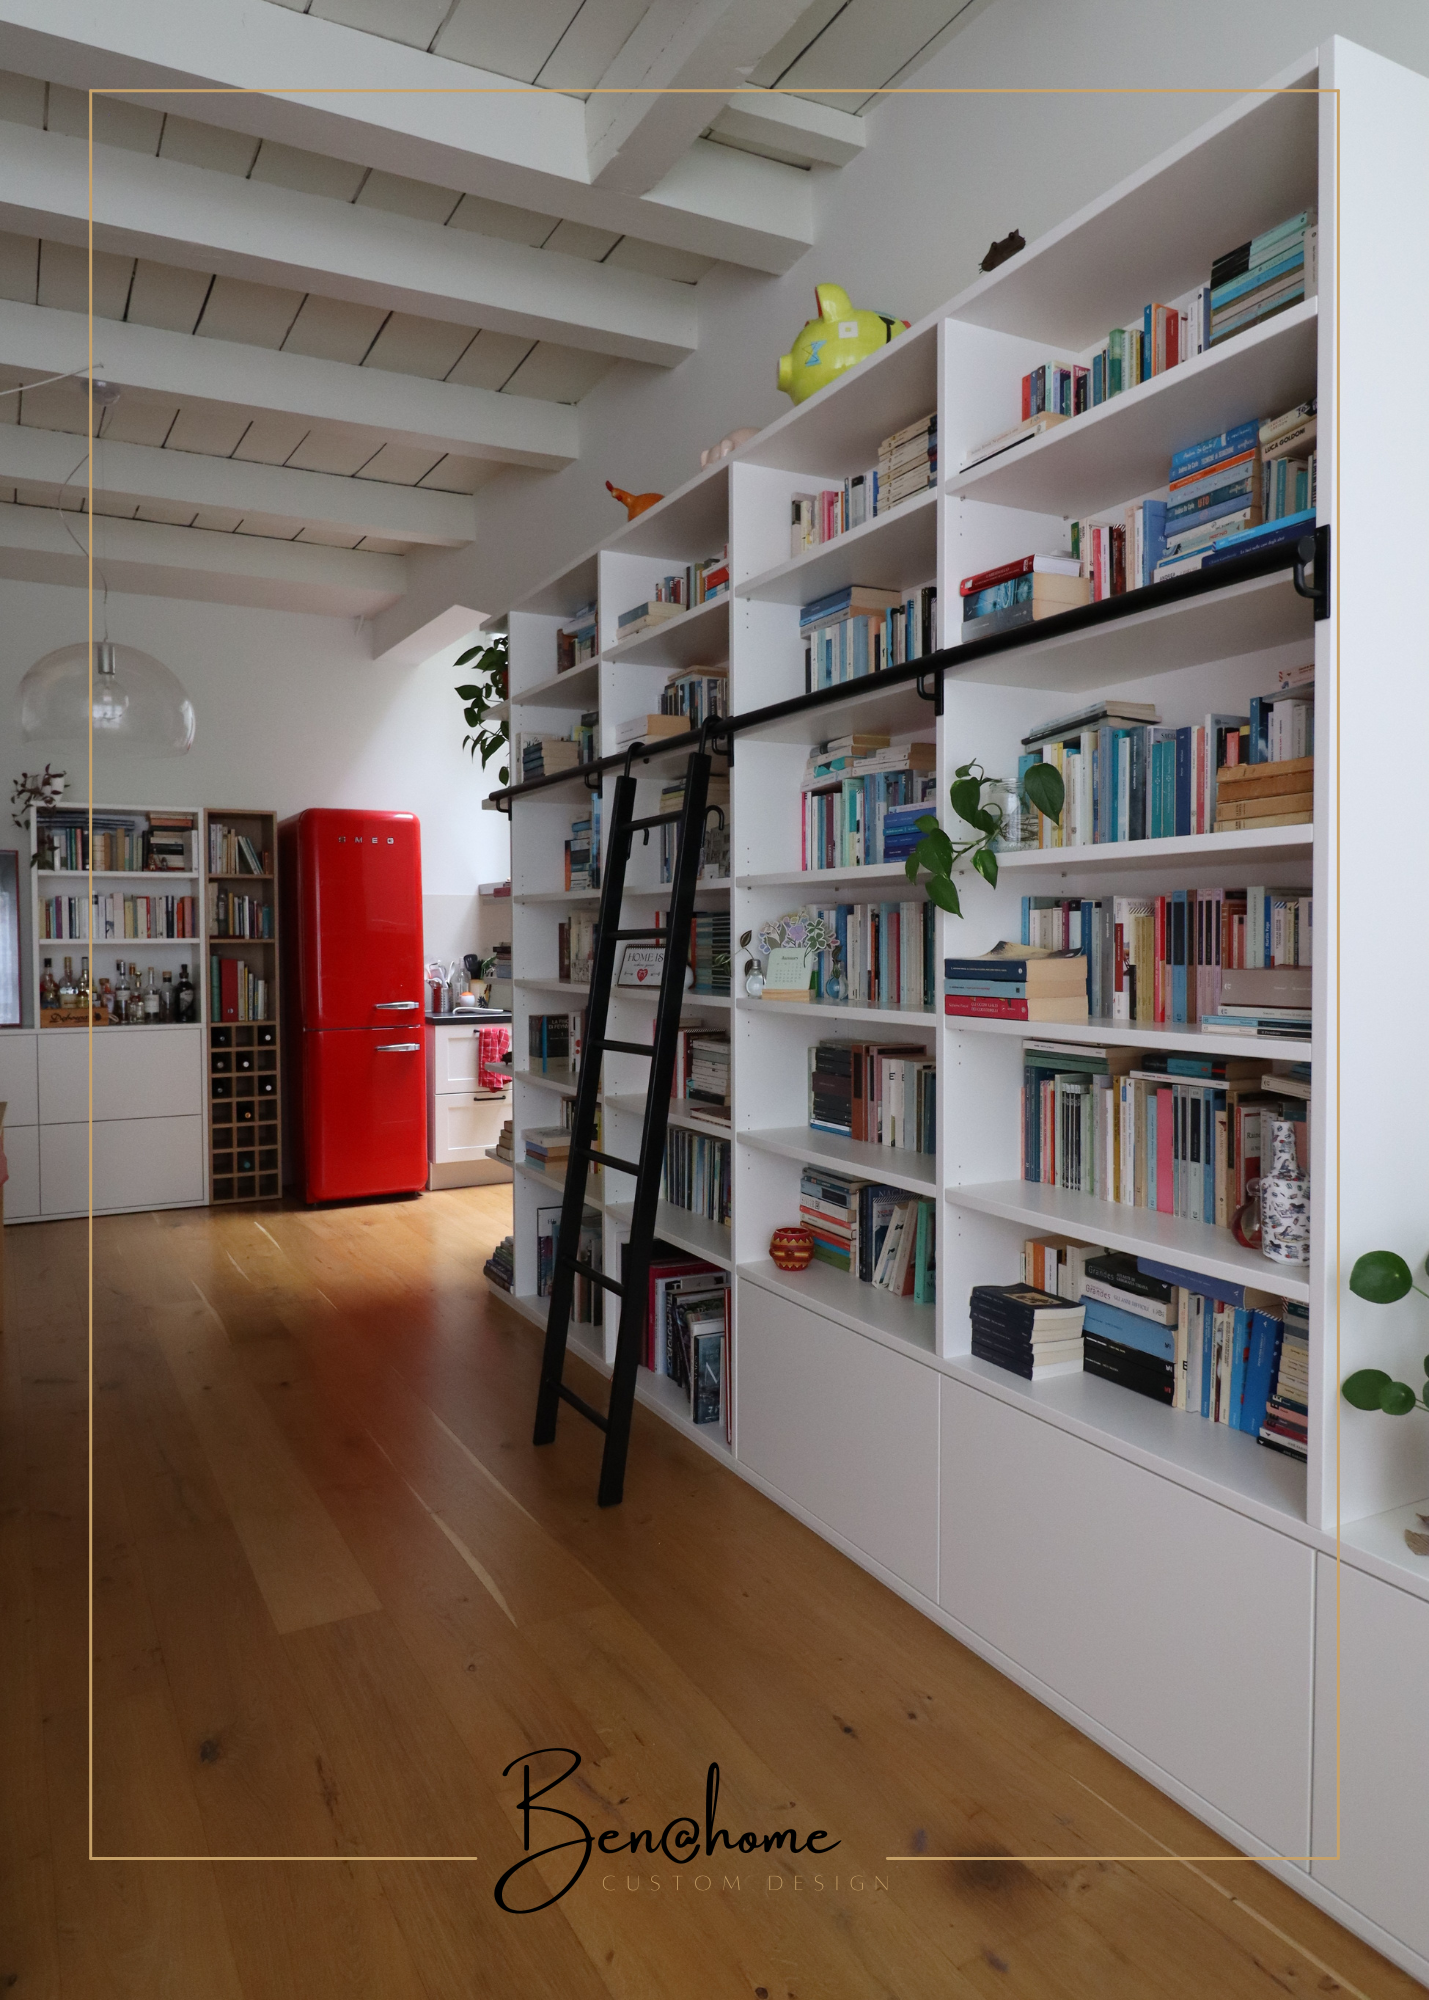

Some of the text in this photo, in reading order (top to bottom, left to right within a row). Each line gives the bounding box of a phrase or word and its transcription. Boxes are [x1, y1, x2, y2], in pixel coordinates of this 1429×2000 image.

[1264, 427, 1306, 454] LUCA GOLDONI
[1197, 495, 1210, 508] UTO
[338, 835, 394, 845] SMEG
[627, 952, 664, 962] HOME IS
[1088, 1265, 1115, 1281] Grandes
[1085, 1284, 1111, 1300] Grandes
